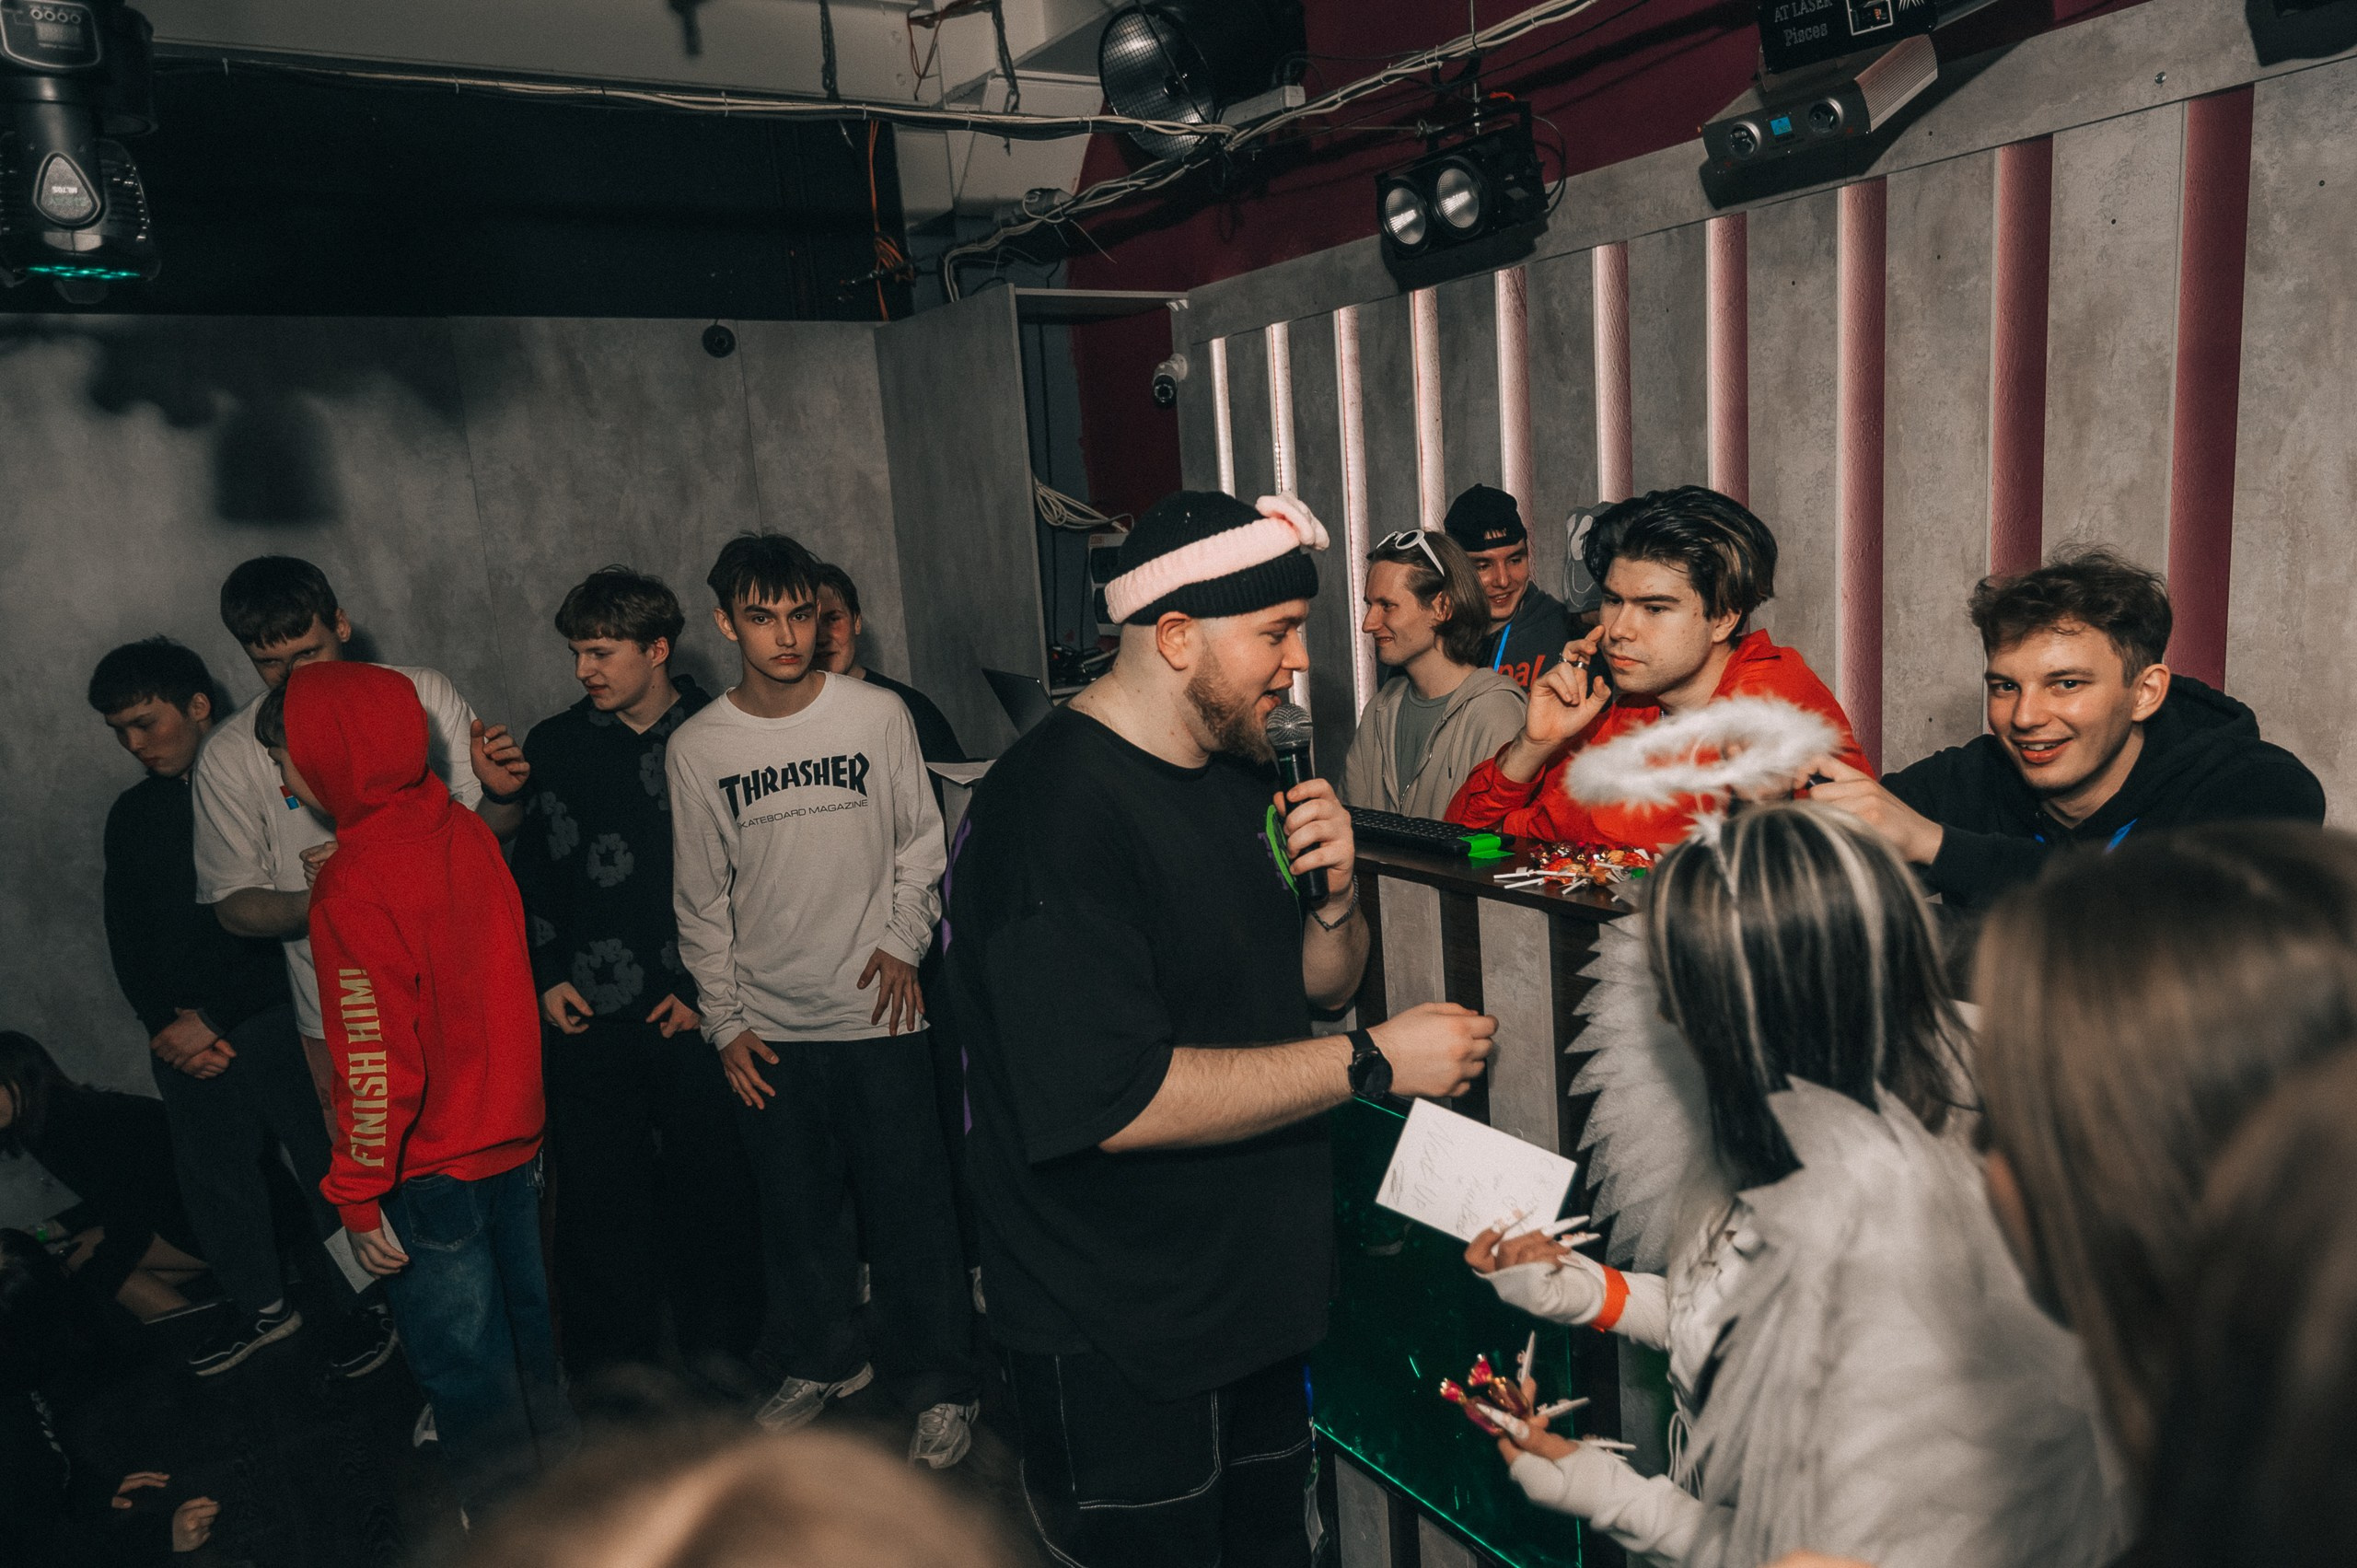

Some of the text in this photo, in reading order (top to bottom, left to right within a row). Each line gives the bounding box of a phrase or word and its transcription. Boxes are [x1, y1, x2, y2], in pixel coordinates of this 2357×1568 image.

[1782, 23, 1829, 46] Pisces
[718, 751, 870, 820] THRASHER
[808, 797, 869, 815] MAGAZINE
[339, 969, 388, 1167] FINISH HIM!
